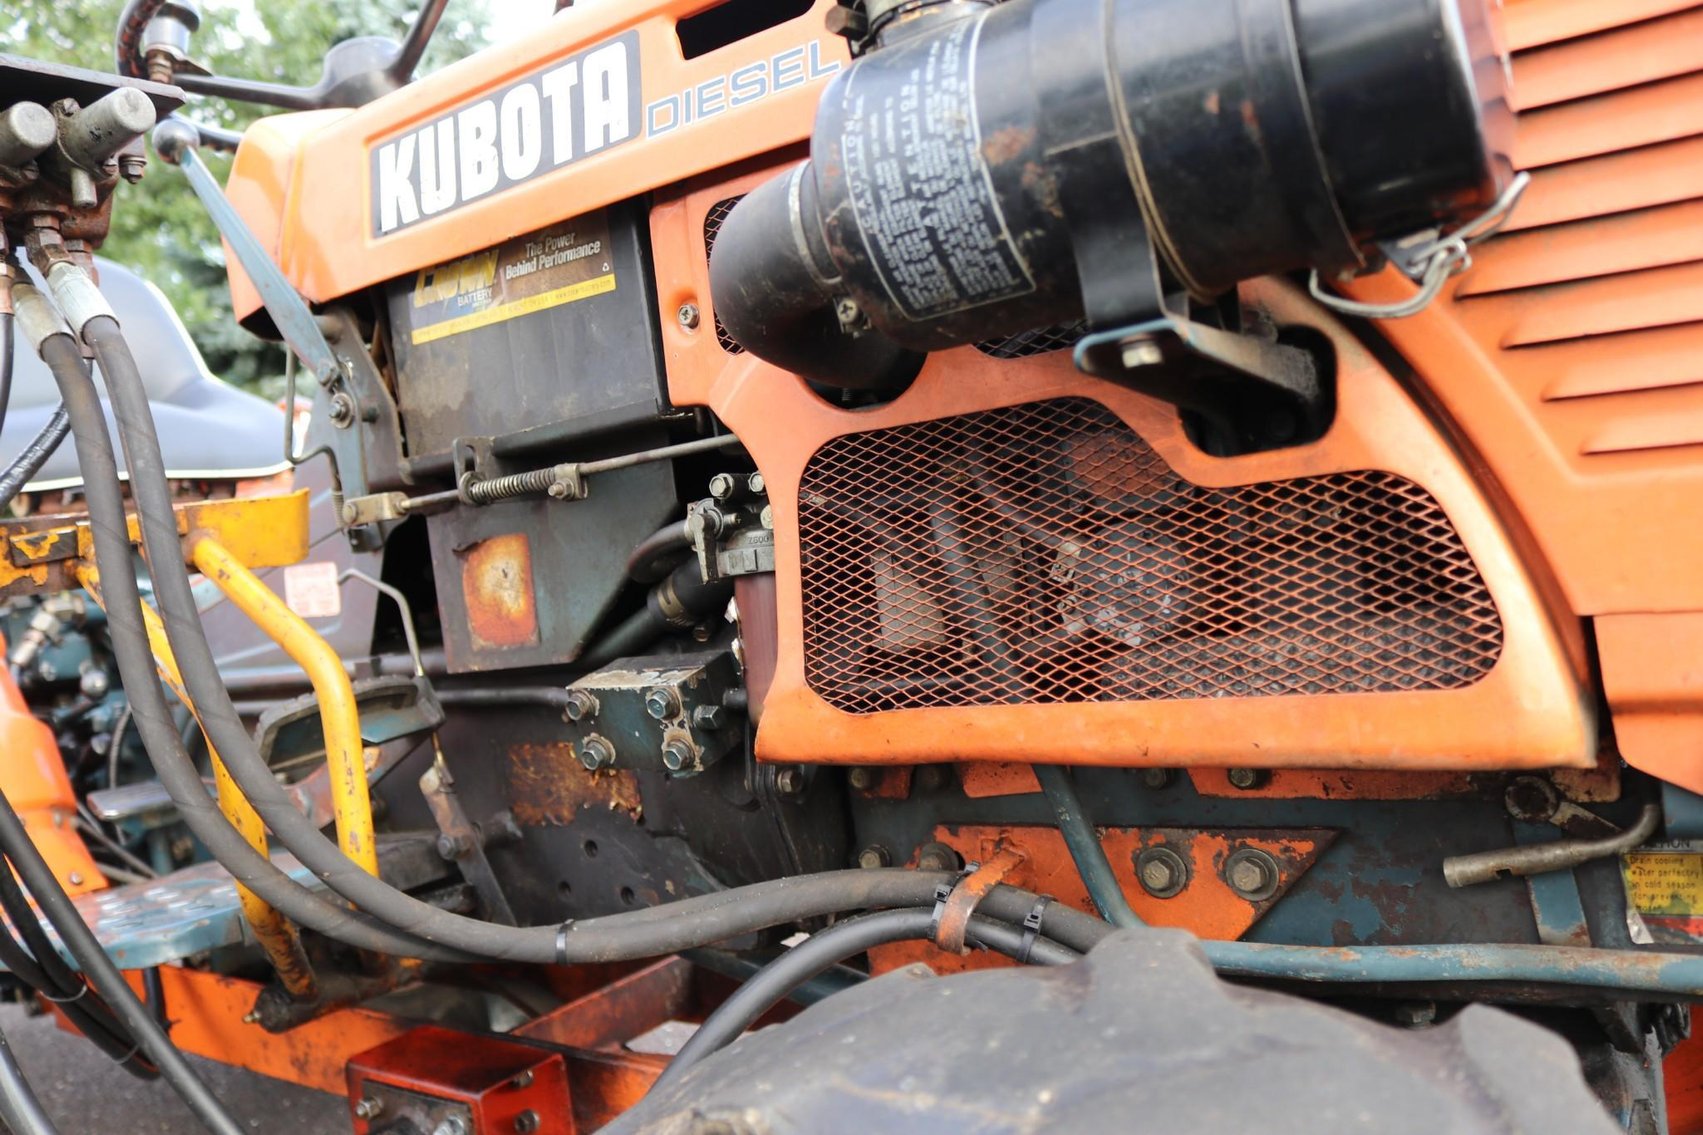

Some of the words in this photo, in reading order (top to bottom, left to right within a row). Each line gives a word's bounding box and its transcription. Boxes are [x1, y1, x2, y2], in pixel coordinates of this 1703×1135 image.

[379, 41, 630, 233] KUBOTA
[646, 38, 842, 138] DIESEL
[506, 260, 537, 280] Behind
[538, 240, 602, 271] Performance
[525, 242, 543, 258] The
[545, 232, 576, 253] Power
[457, 287, 493, 307] BATTERY
